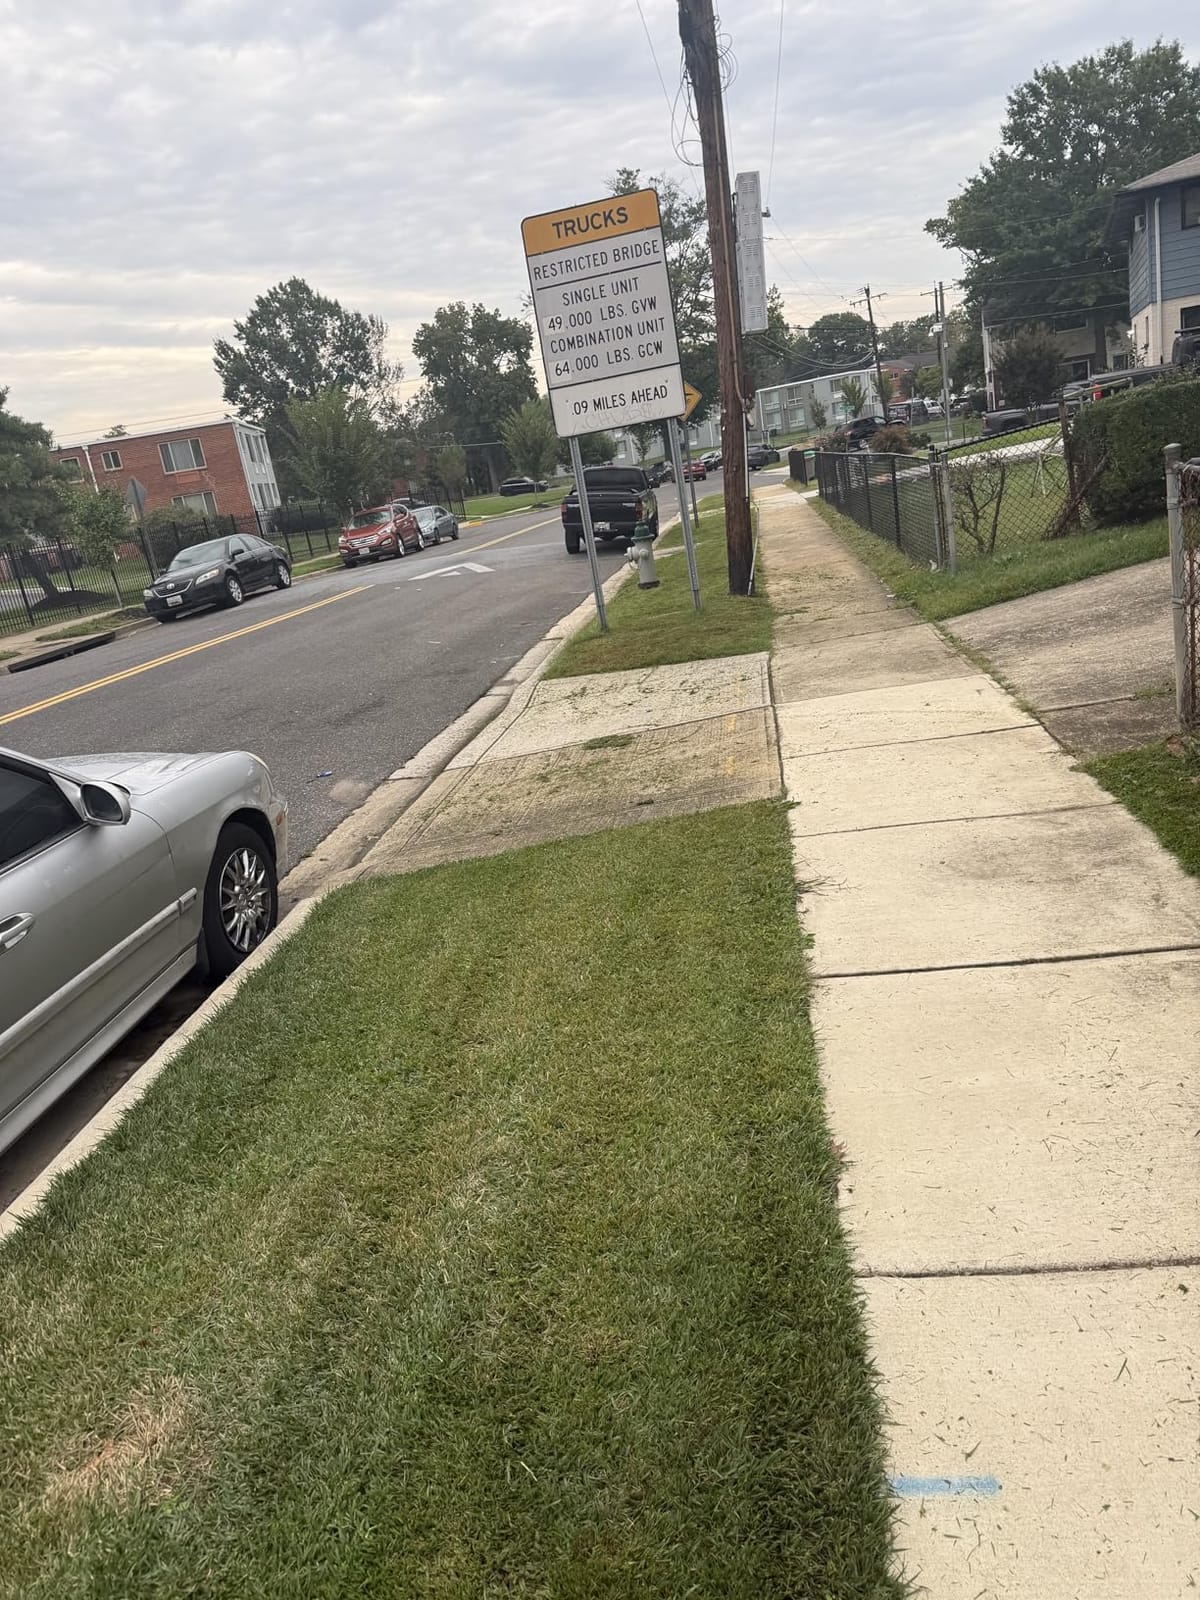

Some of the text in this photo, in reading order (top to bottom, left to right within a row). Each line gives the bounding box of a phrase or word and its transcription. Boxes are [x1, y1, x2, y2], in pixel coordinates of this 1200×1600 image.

[552, 207, 628, 239] TRUCKS
[533, 240, 660, 280] RESTRICTED BRIDGE
[562, 277, 639, 306] SINGLE UNIT
[600, 304, 628, 321] LBS.
[631, 295, 657, 314] GVW
[550, 317, 665, 354] COMBINATION UNIT
[607, 347, 634, 365] LBS.
[638, 340, 663, 358] GCW
[571, 384, 668, 416] .09 MILES AHEAD
